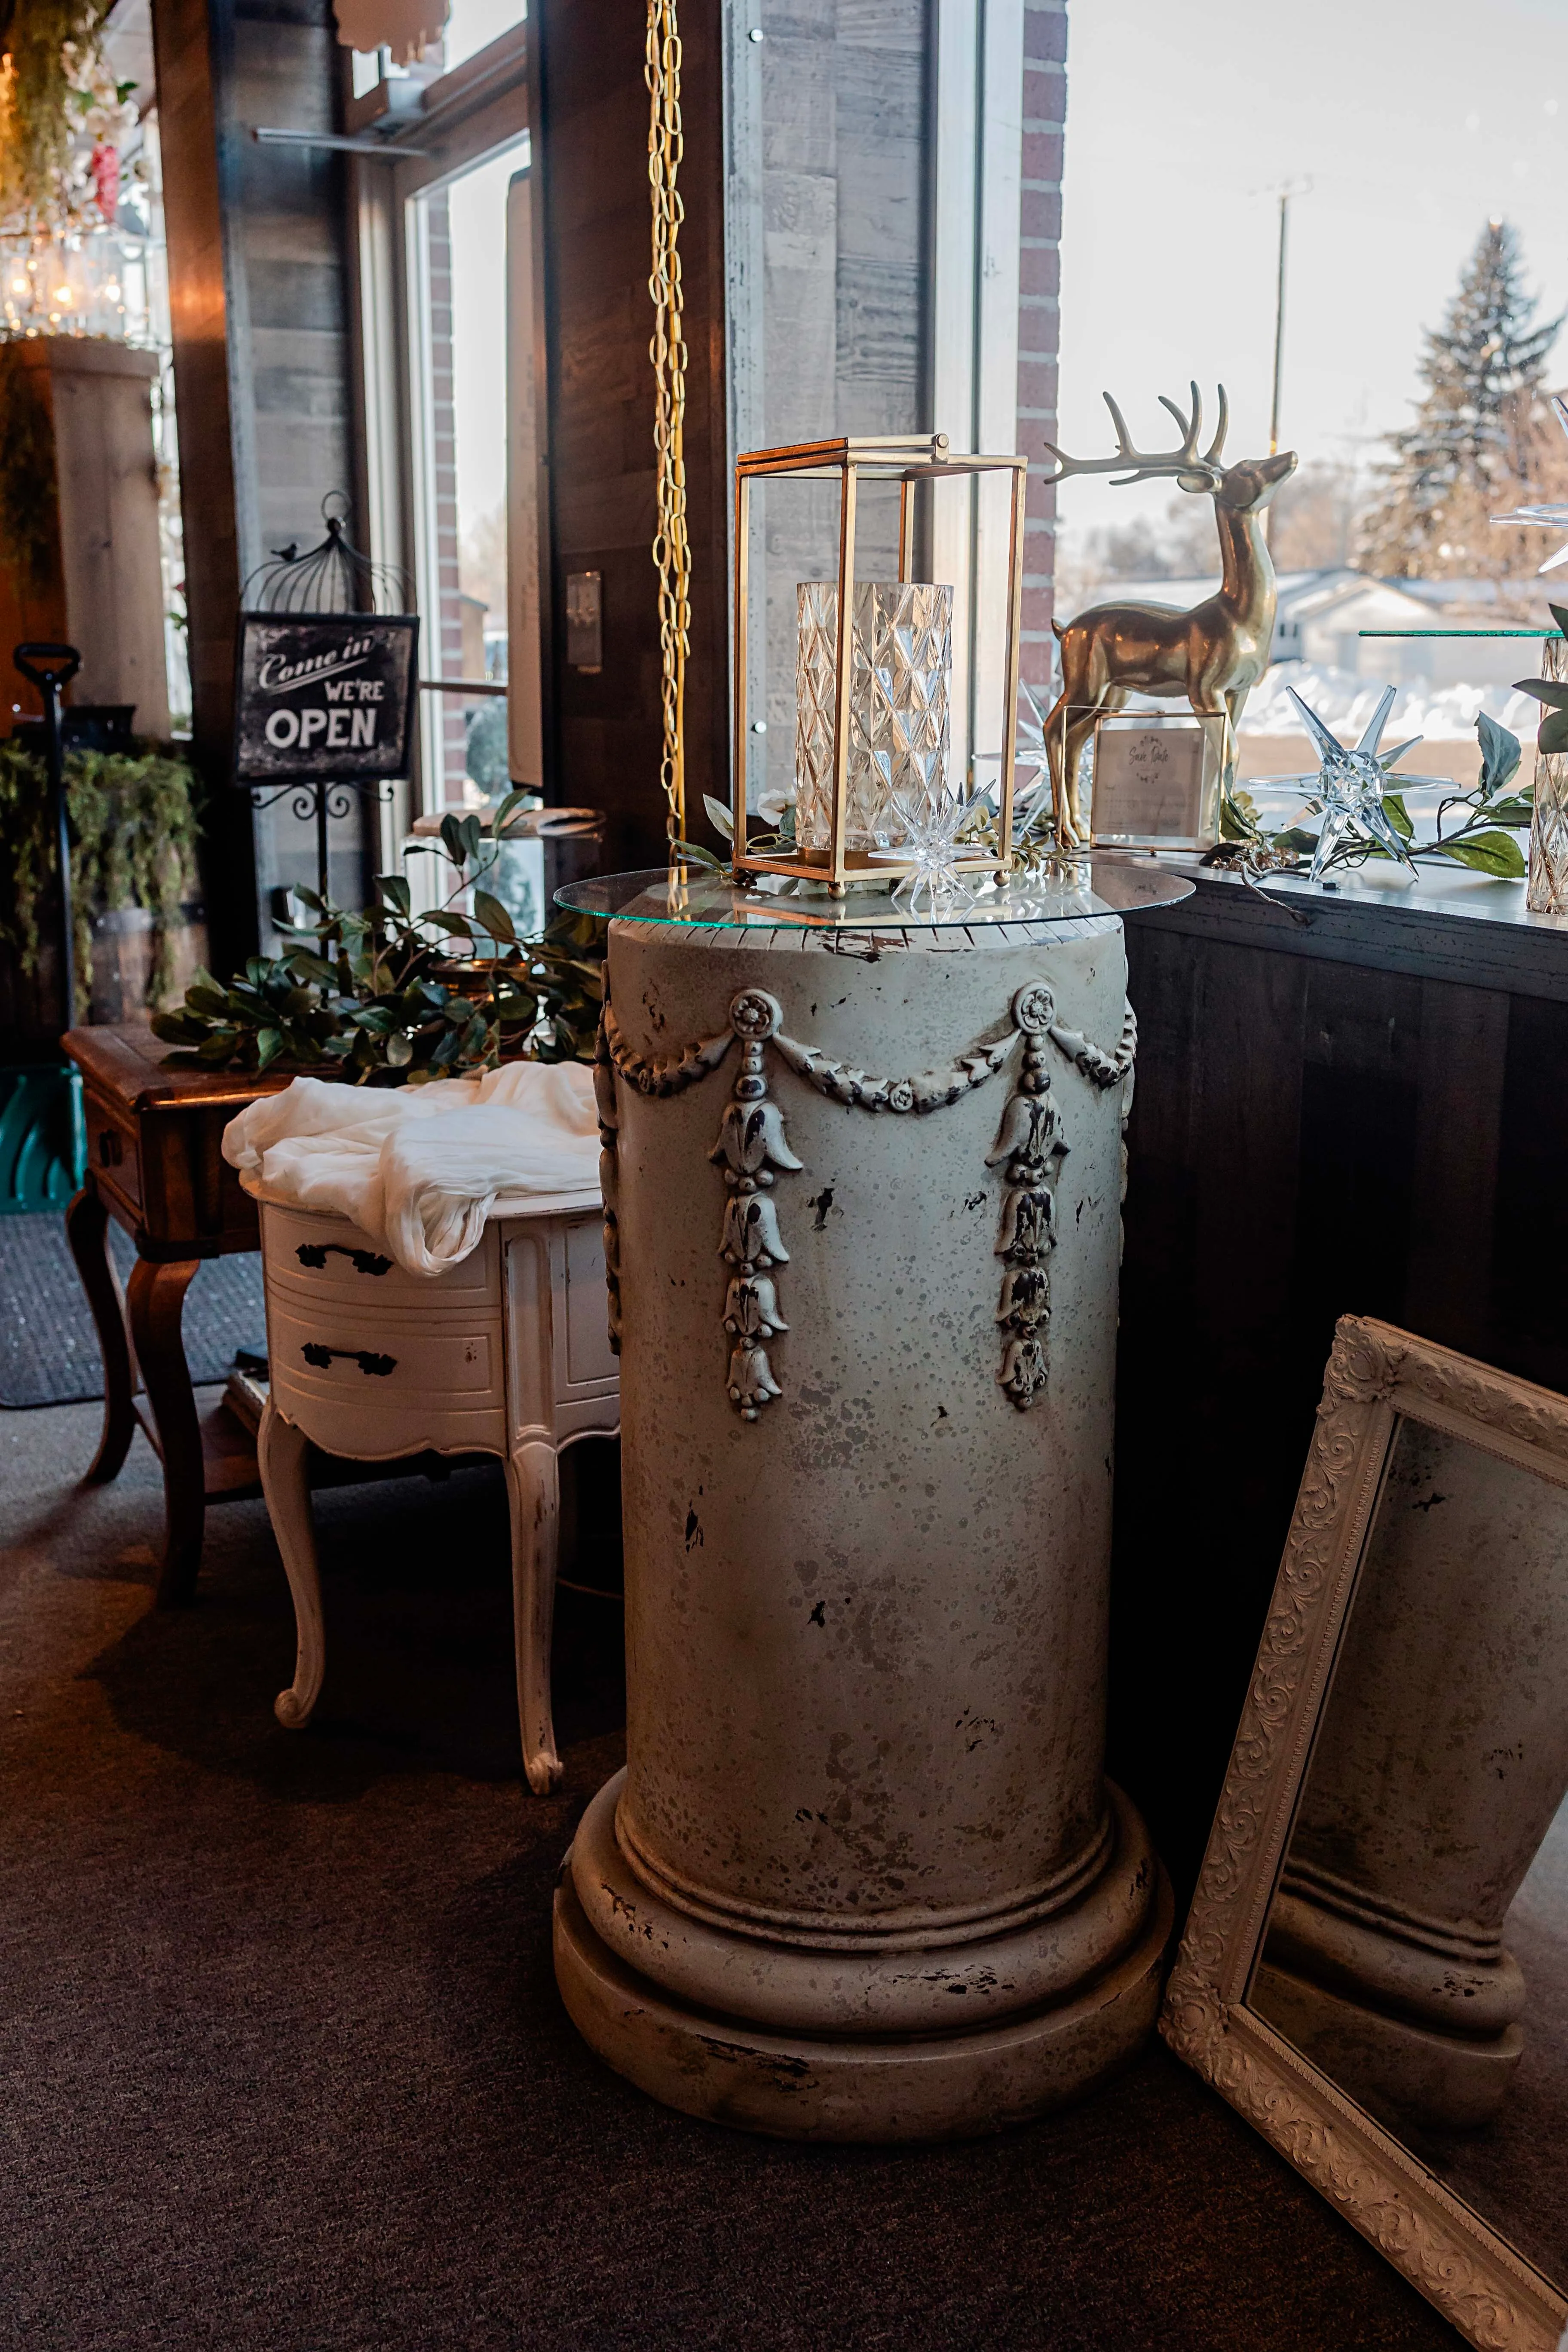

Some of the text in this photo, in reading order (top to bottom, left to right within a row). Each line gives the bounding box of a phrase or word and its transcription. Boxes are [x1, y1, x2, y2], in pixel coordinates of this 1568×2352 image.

[259, 636, 377, 689] Come in
[324, 678, 385, 702] WE'RE
[265, 708, 377, 749] OPEN
[1129, 746, 1169, 765] Save Date
